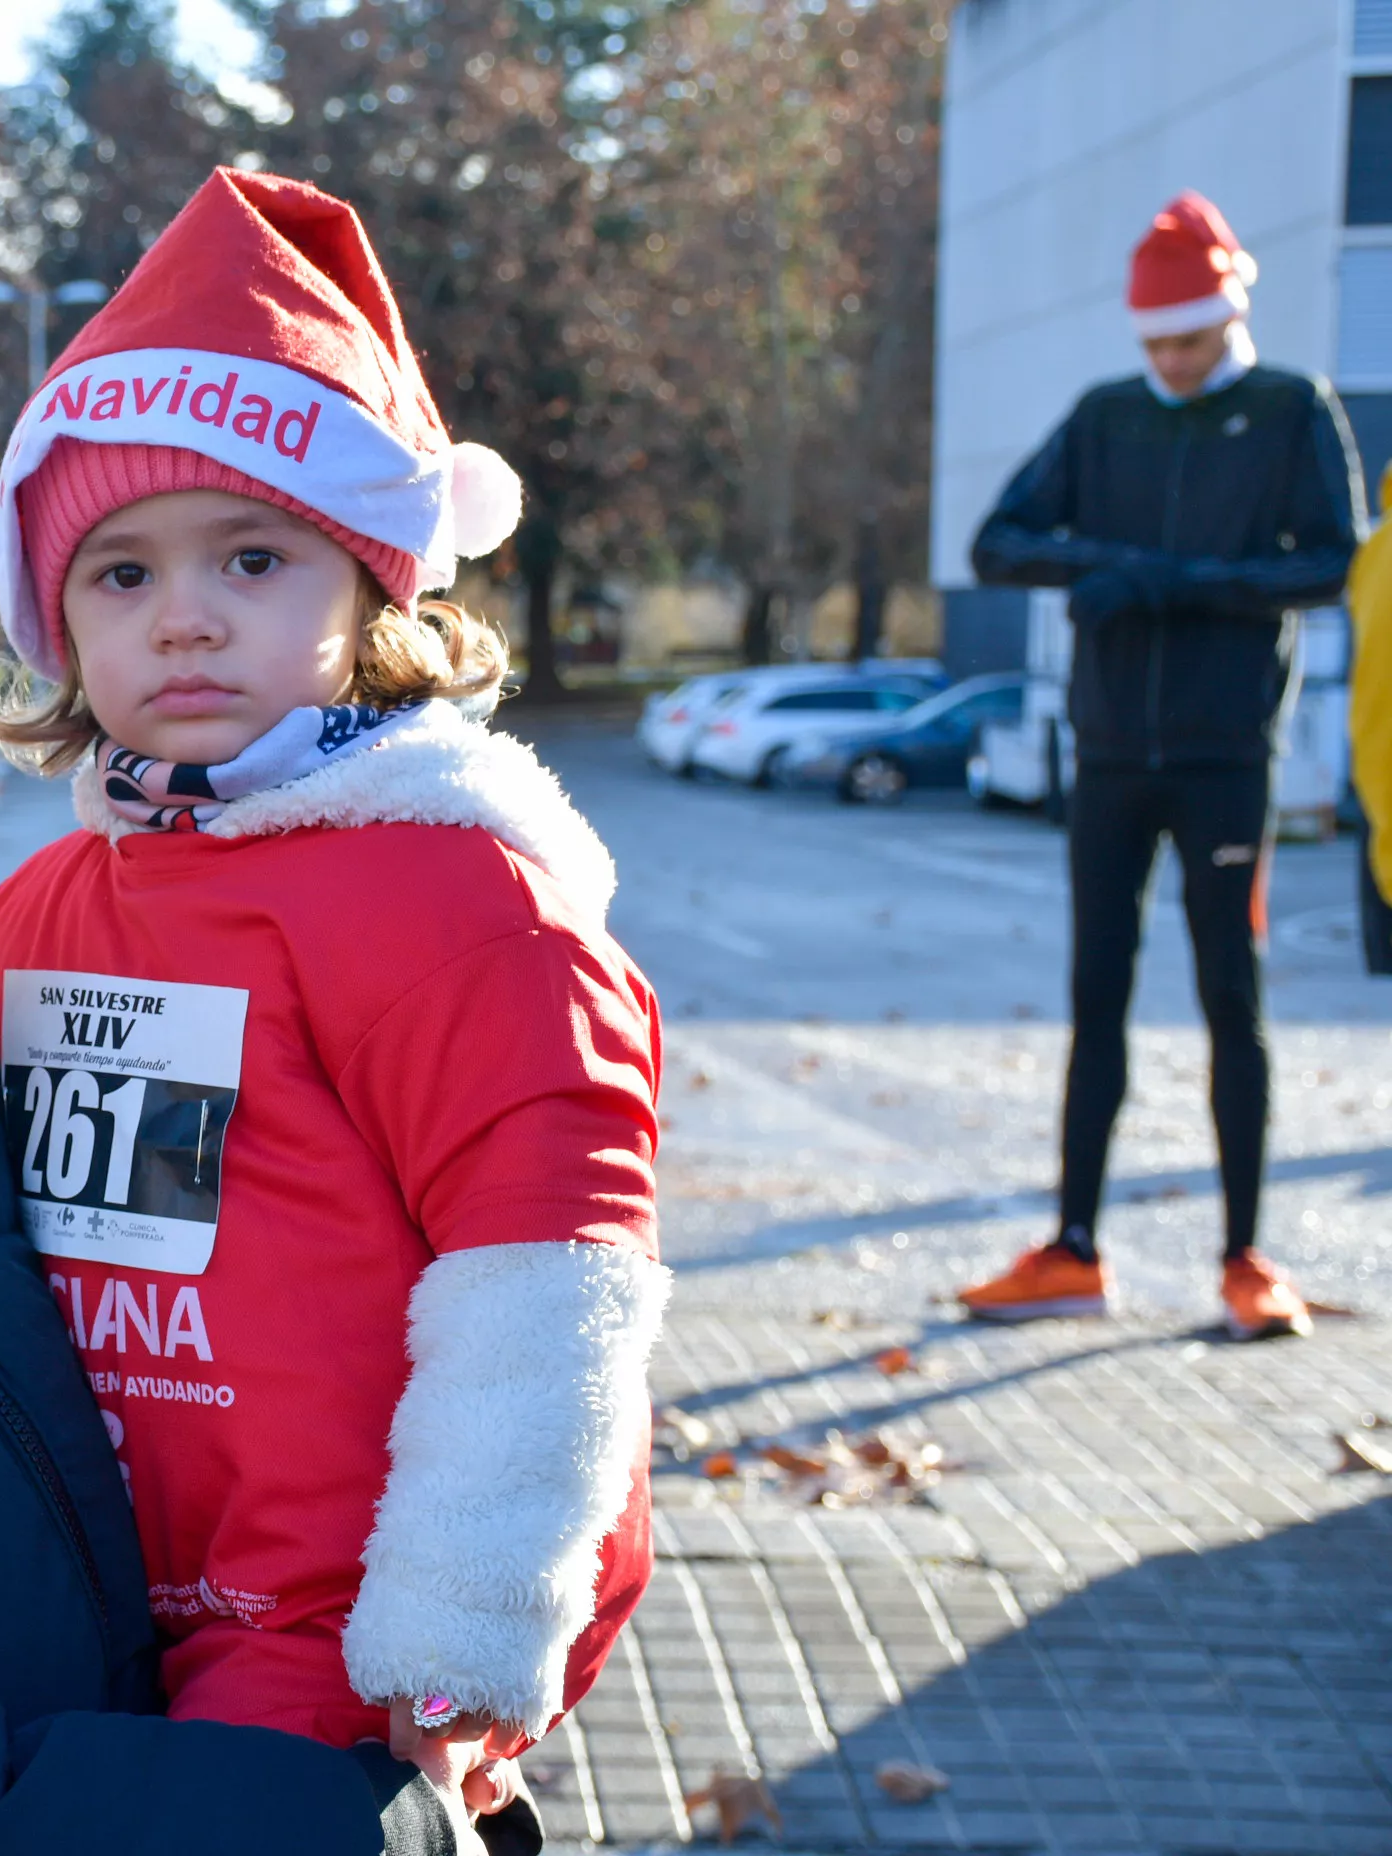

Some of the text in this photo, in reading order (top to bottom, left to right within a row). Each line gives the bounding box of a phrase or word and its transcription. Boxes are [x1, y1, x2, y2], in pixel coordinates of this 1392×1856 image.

[40, 365, 321, 464] Navidad
[40, 987, 166, 1015] SAN SILVESTRE
[60, 1011, 137, 1050] XLIV
[83, 1051, 114, 1069] tiempo
[22, 1066, 147, 1206] 261
[87, 1371, 235, 1408] IEN AYUDANDO
